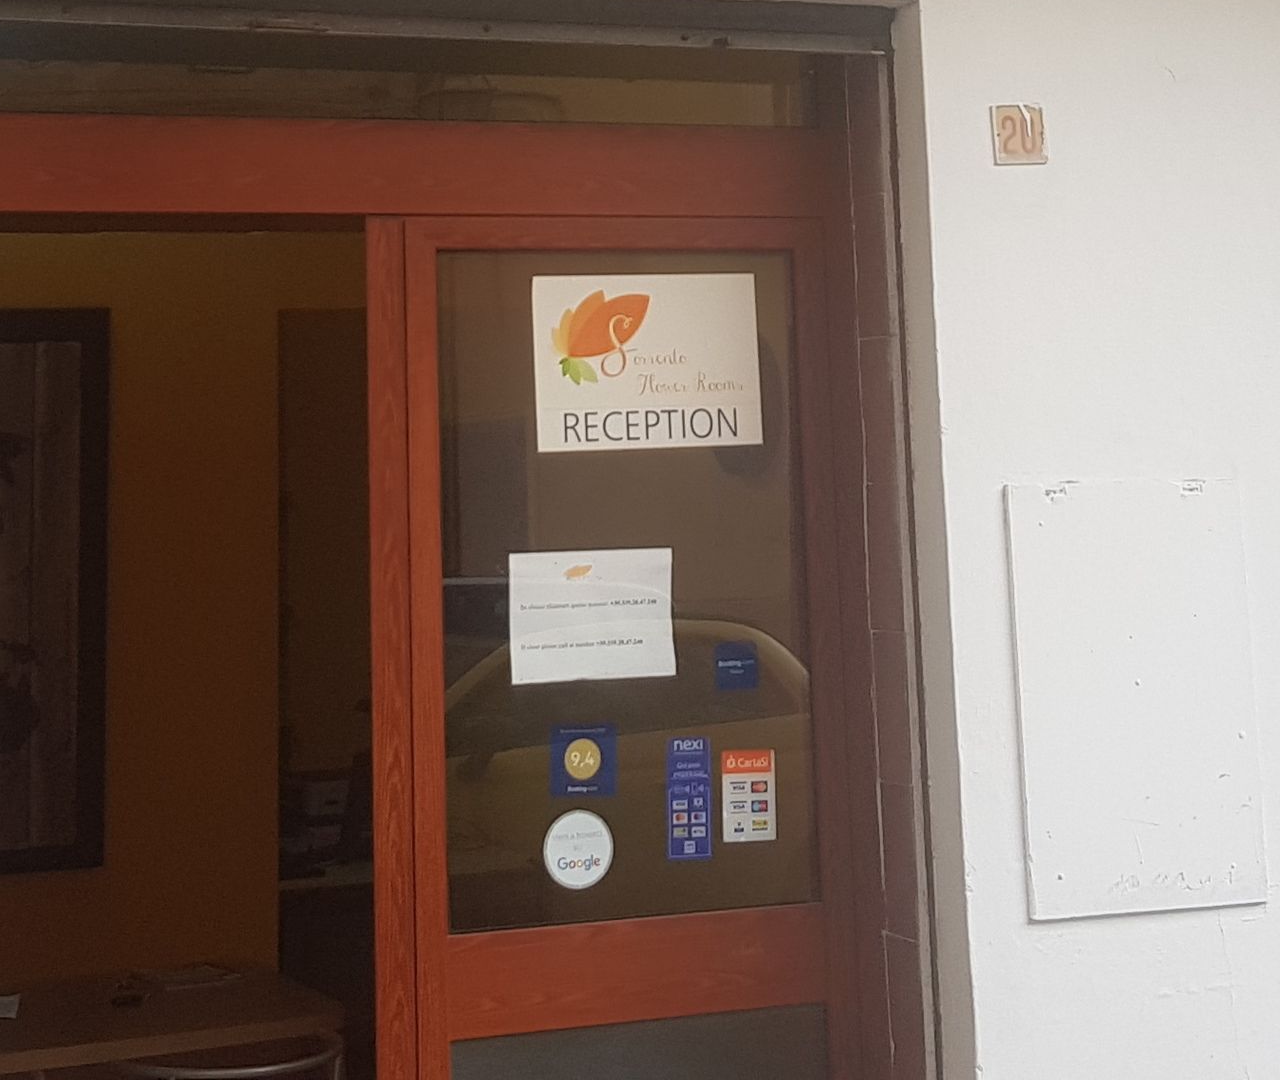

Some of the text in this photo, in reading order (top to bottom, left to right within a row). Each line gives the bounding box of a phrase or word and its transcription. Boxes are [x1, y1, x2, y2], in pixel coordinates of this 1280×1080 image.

[563, 407, 739, 443] RECEPTION
[673, 739, 703, 751] nexi
[571, 751, 595, 767] 9,4
[557, 854, 601, 871] Google
